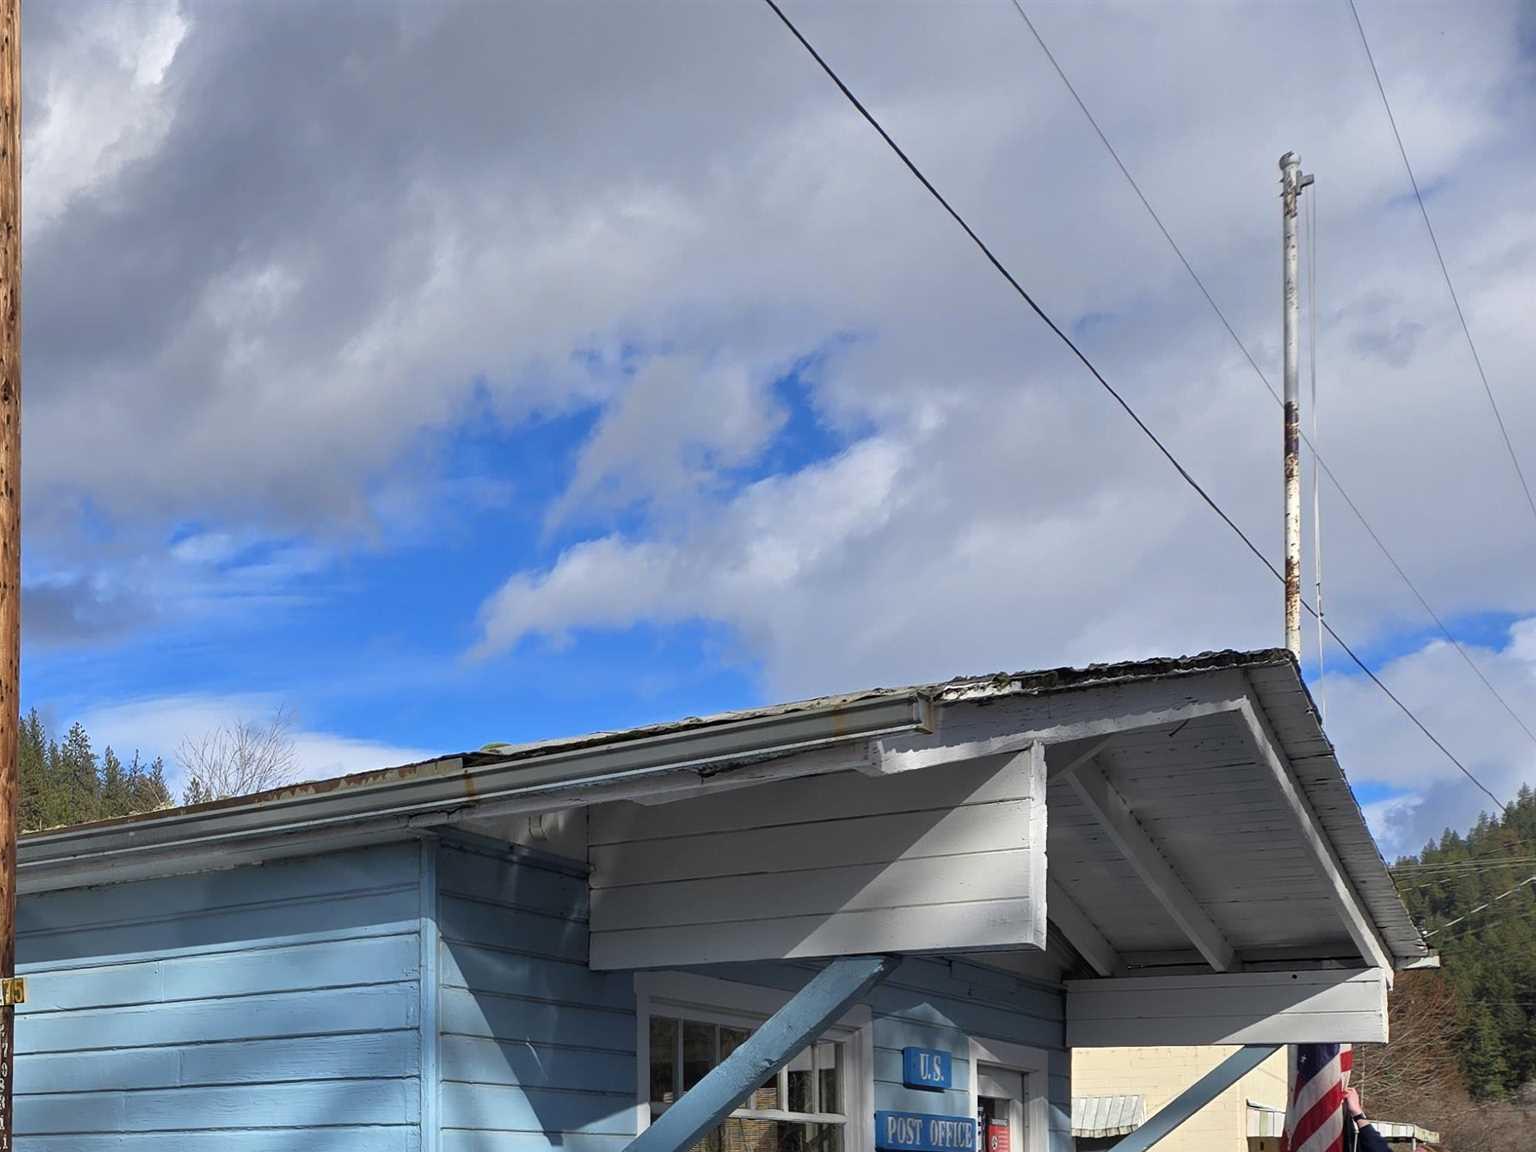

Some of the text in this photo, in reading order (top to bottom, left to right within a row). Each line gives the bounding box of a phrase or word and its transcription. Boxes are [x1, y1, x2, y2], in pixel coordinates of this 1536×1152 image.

[920, 1053, 944, 1081] U.S.
[887, 1116, 923, 1145] POST
[930, 1120, 973, 1148] OFFICE
